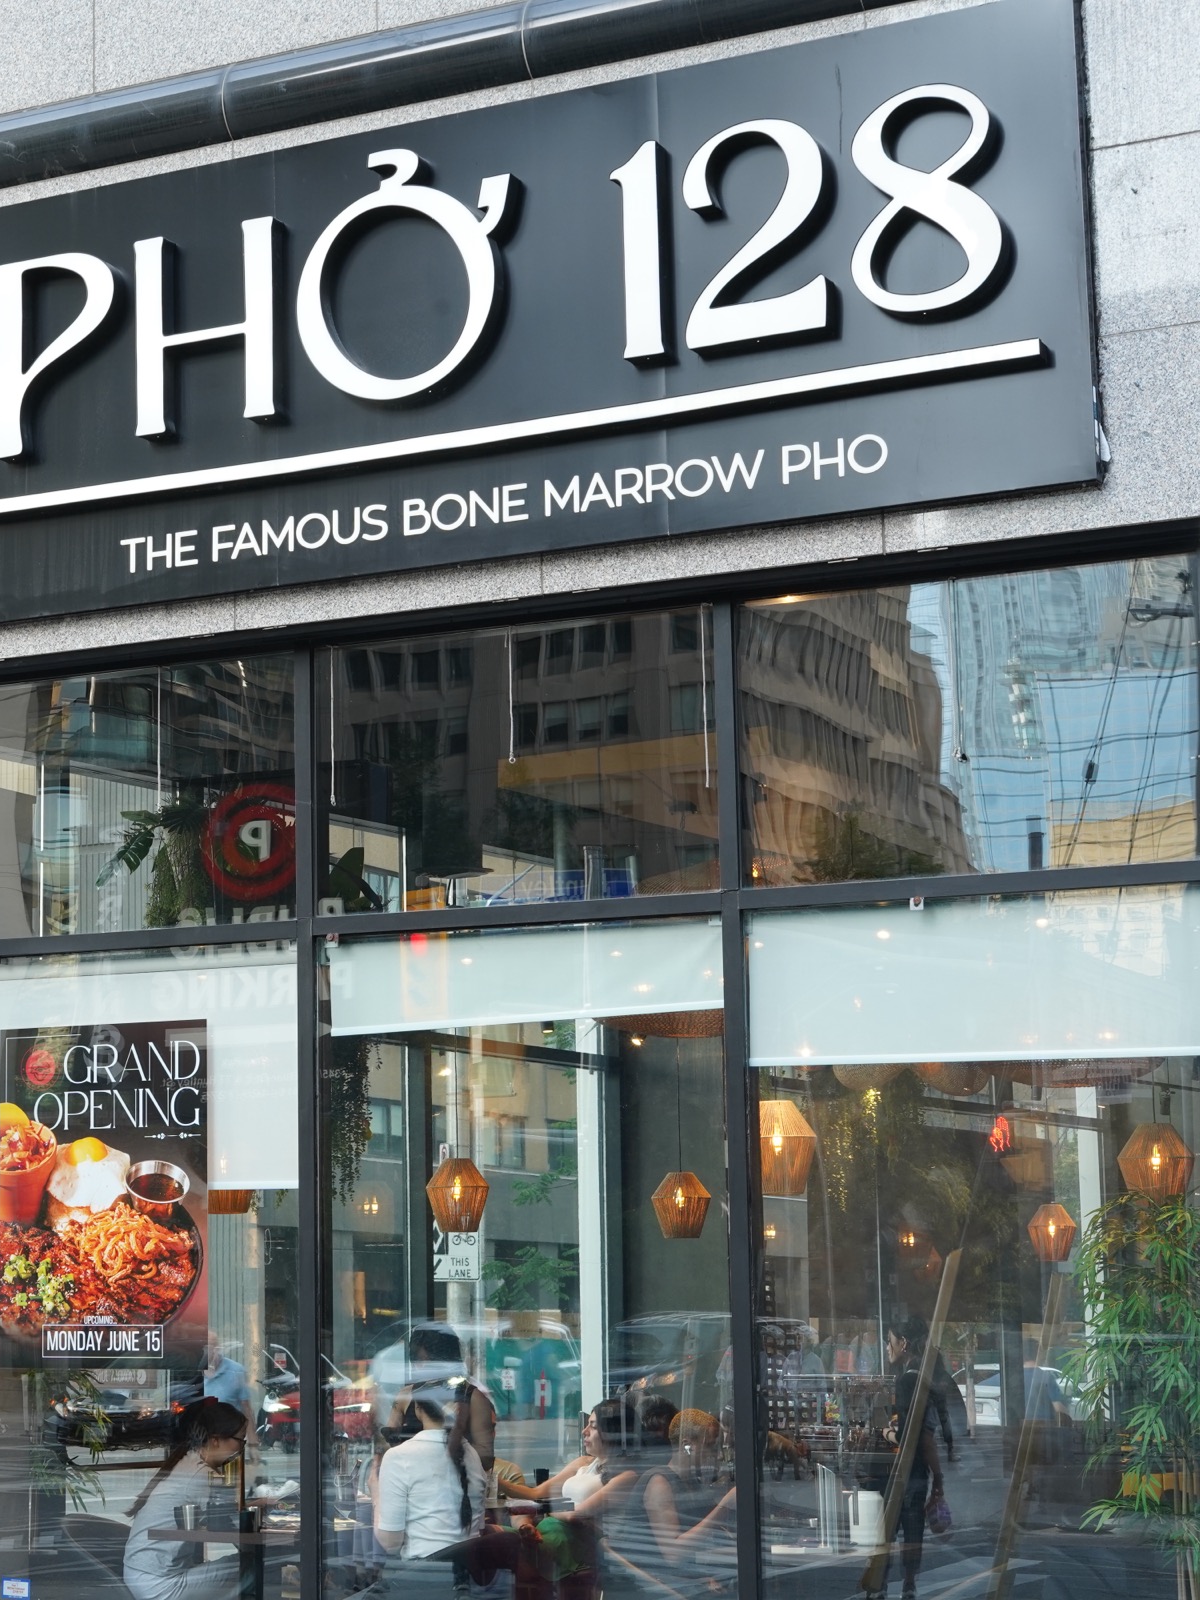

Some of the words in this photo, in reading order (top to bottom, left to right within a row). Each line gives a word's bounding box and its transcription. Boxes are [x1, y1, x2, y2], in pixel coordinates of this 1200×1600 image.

[609, 83, 1003, 362] 128
[120, 530, 198, 574] THE
[212, 504, 388, 562] FAMOUS
[403, 483, 528, 536] BONE
[544, 449, 765, 517] MARROW
[781, 433, 888, 484] PHO
[63, 1040, 201, 1084] GRAND
[34, 1086, 200, 1131] OPENING
[448, 1268, 472, 1278] LANE
[451, 1257, 470, 1267] THIS
[47, 1330, 104, 1352] MONDAY
[106, 1330, 140, 1352] JUNE
[145, 1330, 161, 1352] 15
